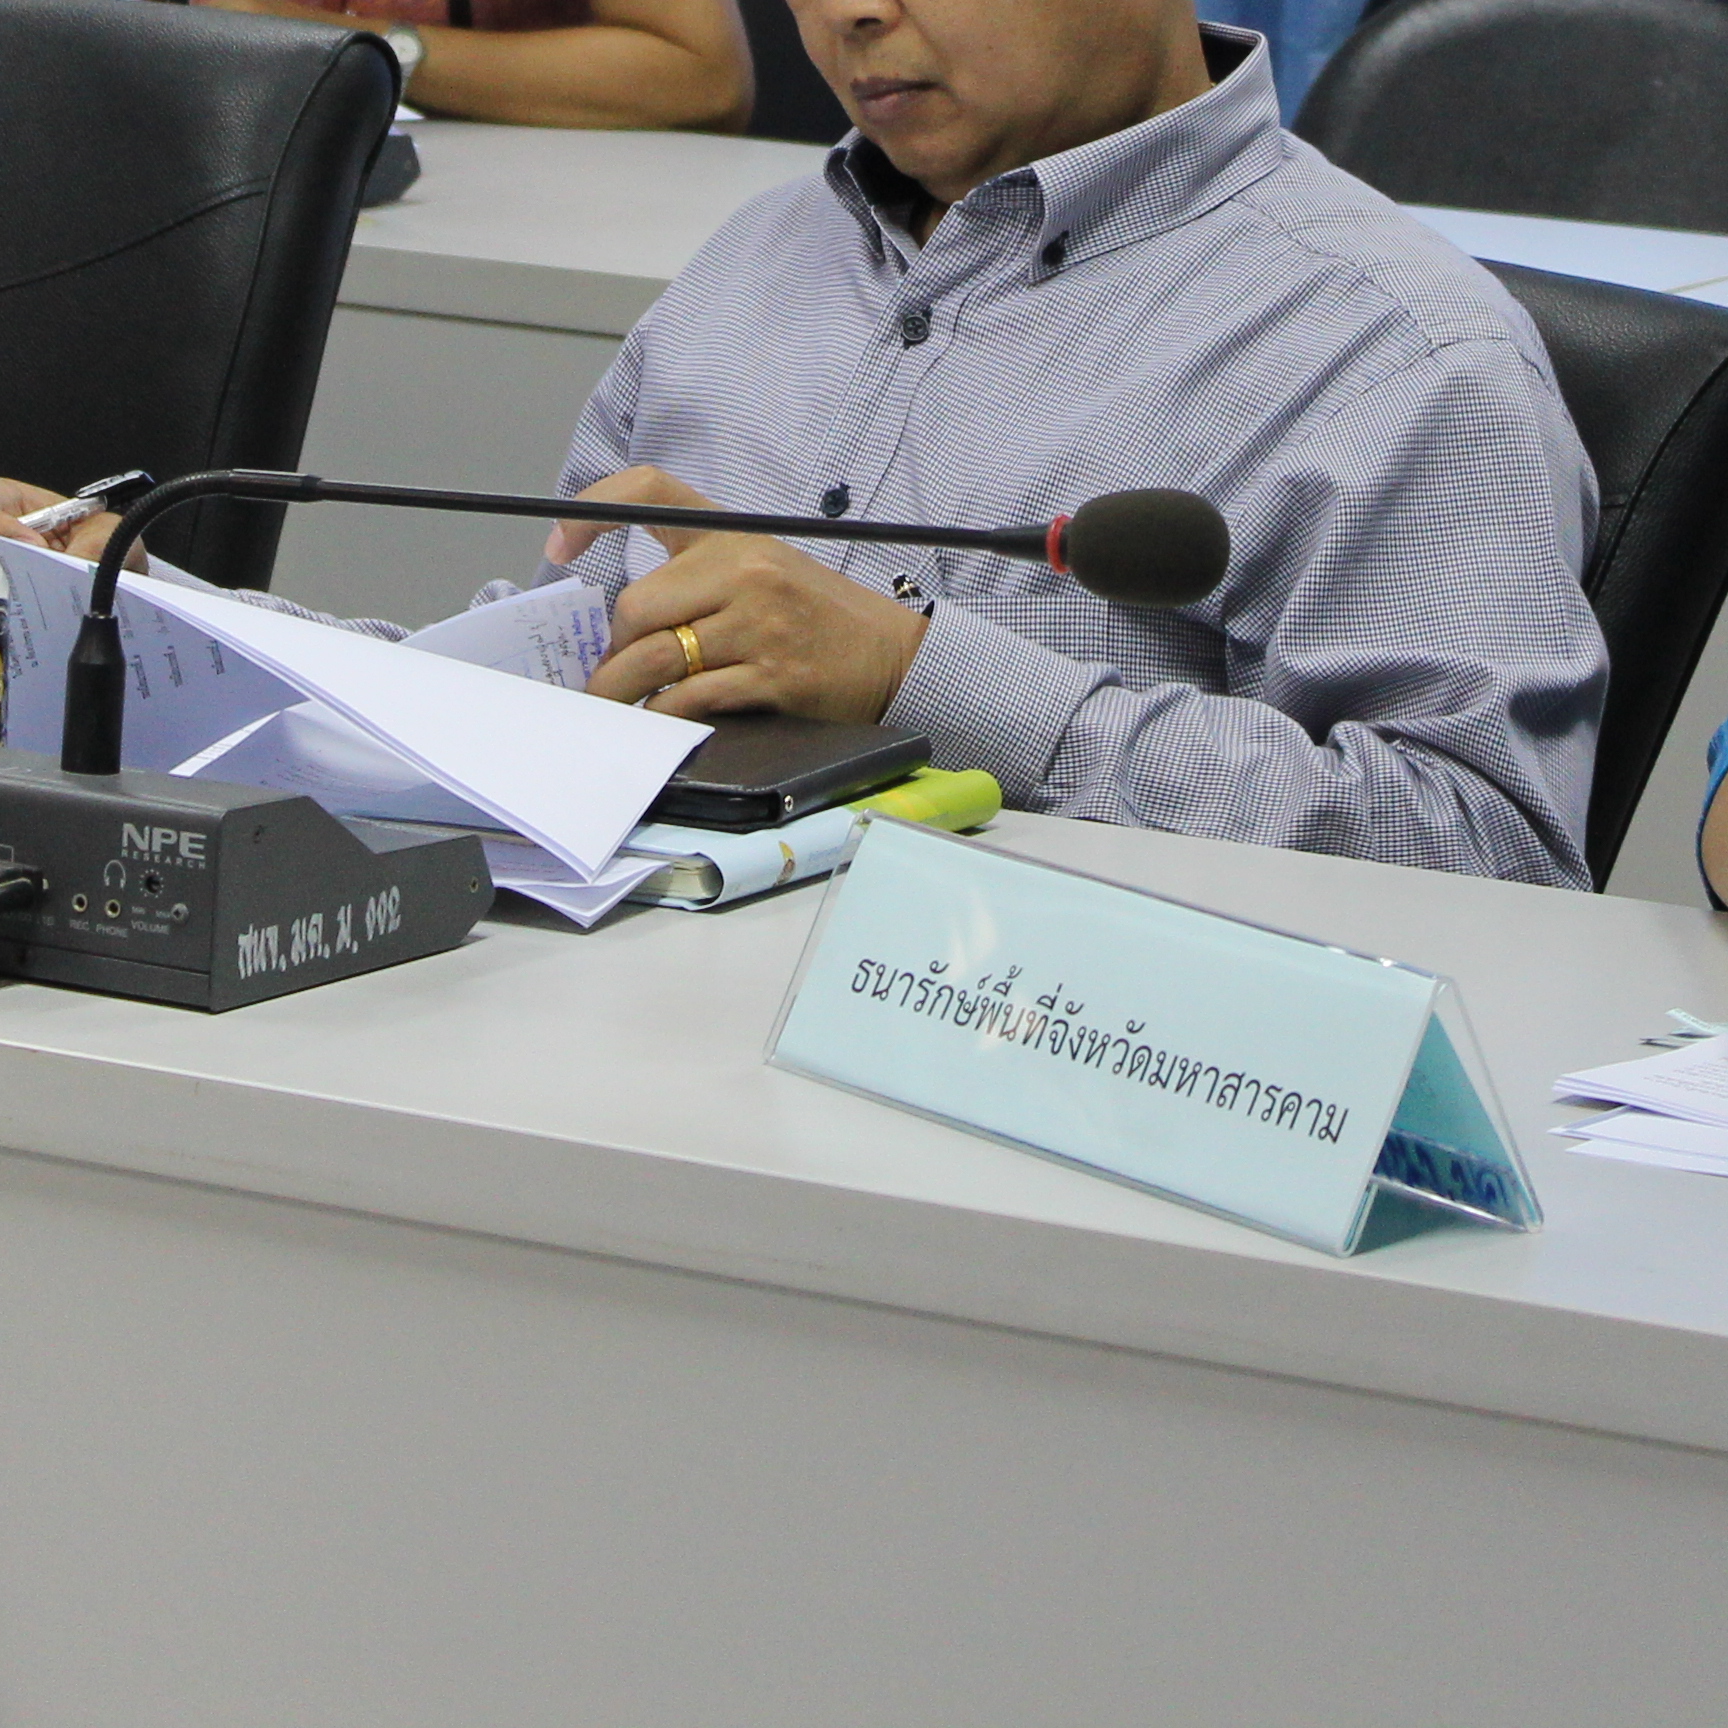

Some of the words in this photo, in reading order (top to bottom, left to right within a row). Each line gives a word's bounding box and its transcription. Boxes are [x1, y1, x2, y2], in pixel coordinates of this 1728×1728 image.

[122, 822, 207, 860] NPE
[121, 849, 206, 870] RESEARCH
[131, 920, 170, 936] VOLUME
[850, 959, 1349, 1144] ธนารักษ์พื้นที่จังหวัดมหาสารคาม
